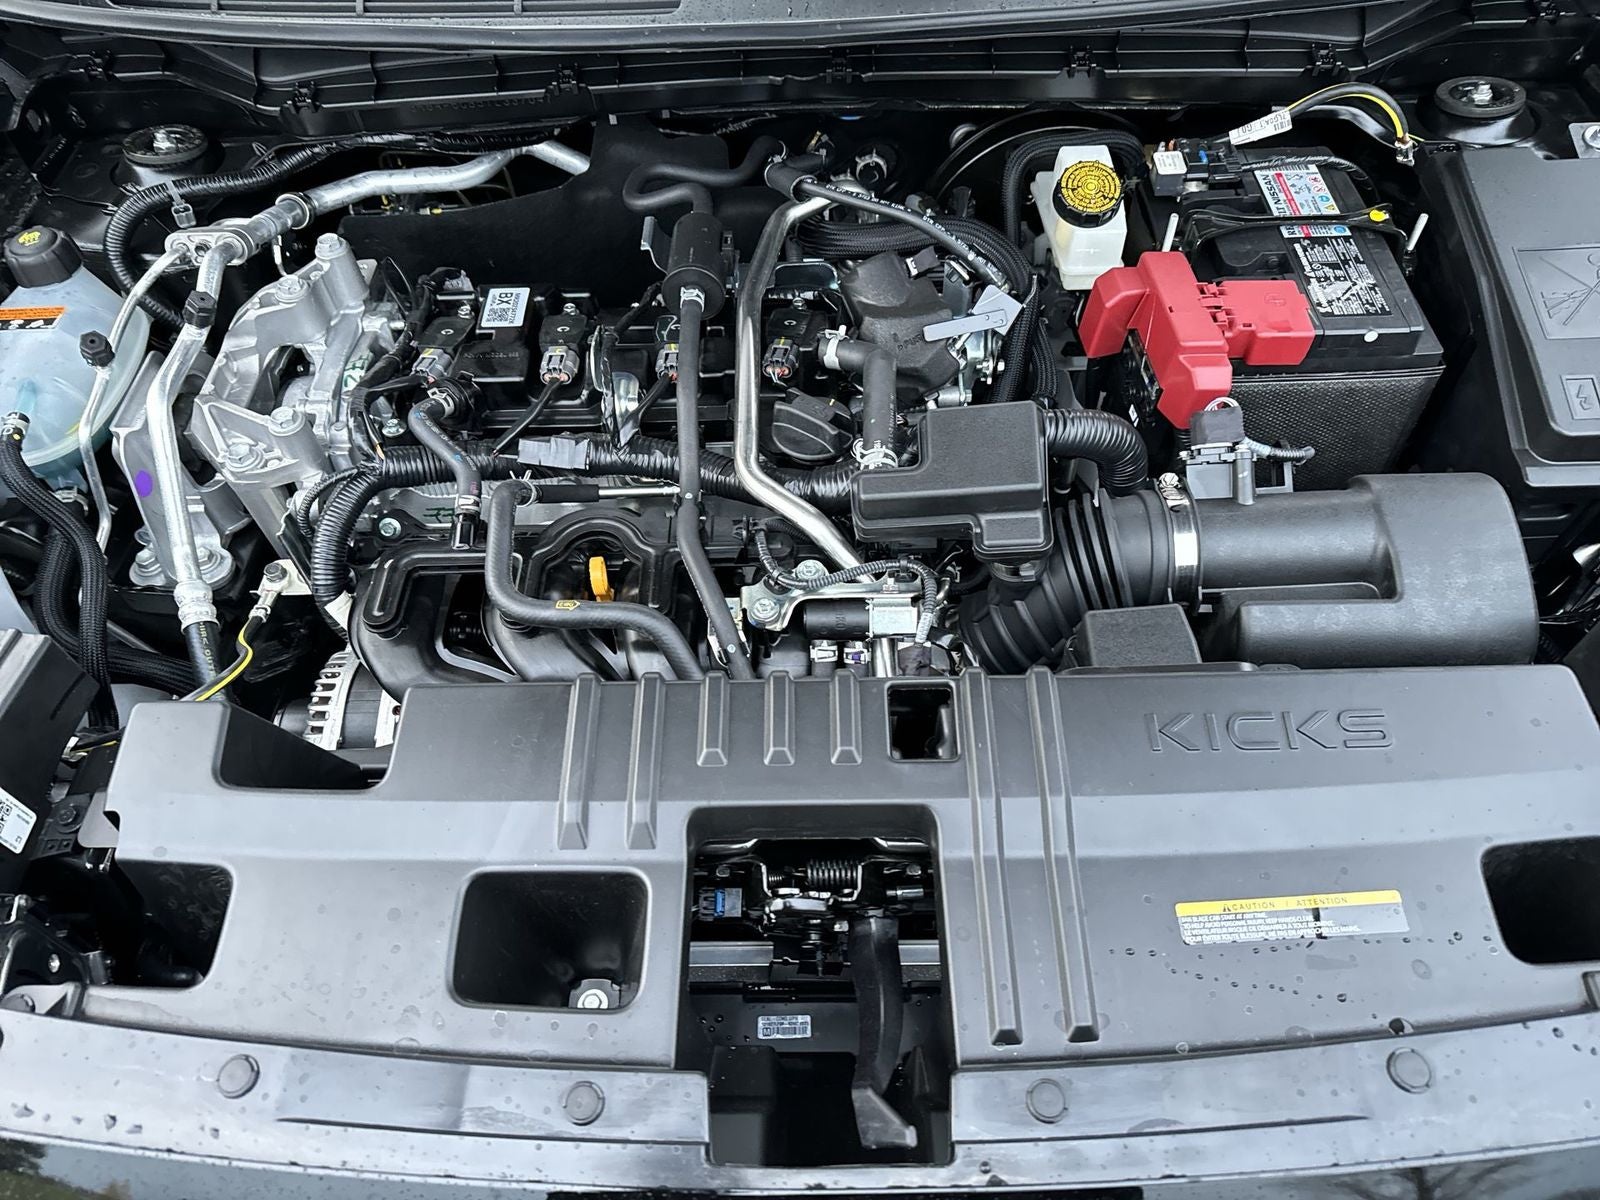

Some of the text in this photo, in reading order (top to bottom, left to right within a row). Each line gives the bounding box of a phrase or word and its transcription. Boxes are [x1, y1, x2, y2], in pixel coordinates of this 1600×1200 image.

[1261, 174, 1281, 205] NISSAN
[497, 292, 514, 306] BX
[1144, 708, 1393, 752] KICKS
[1232, 901, 1276, 911] CAUTION
[1296, 896, 1349, 906] ATTENTION
